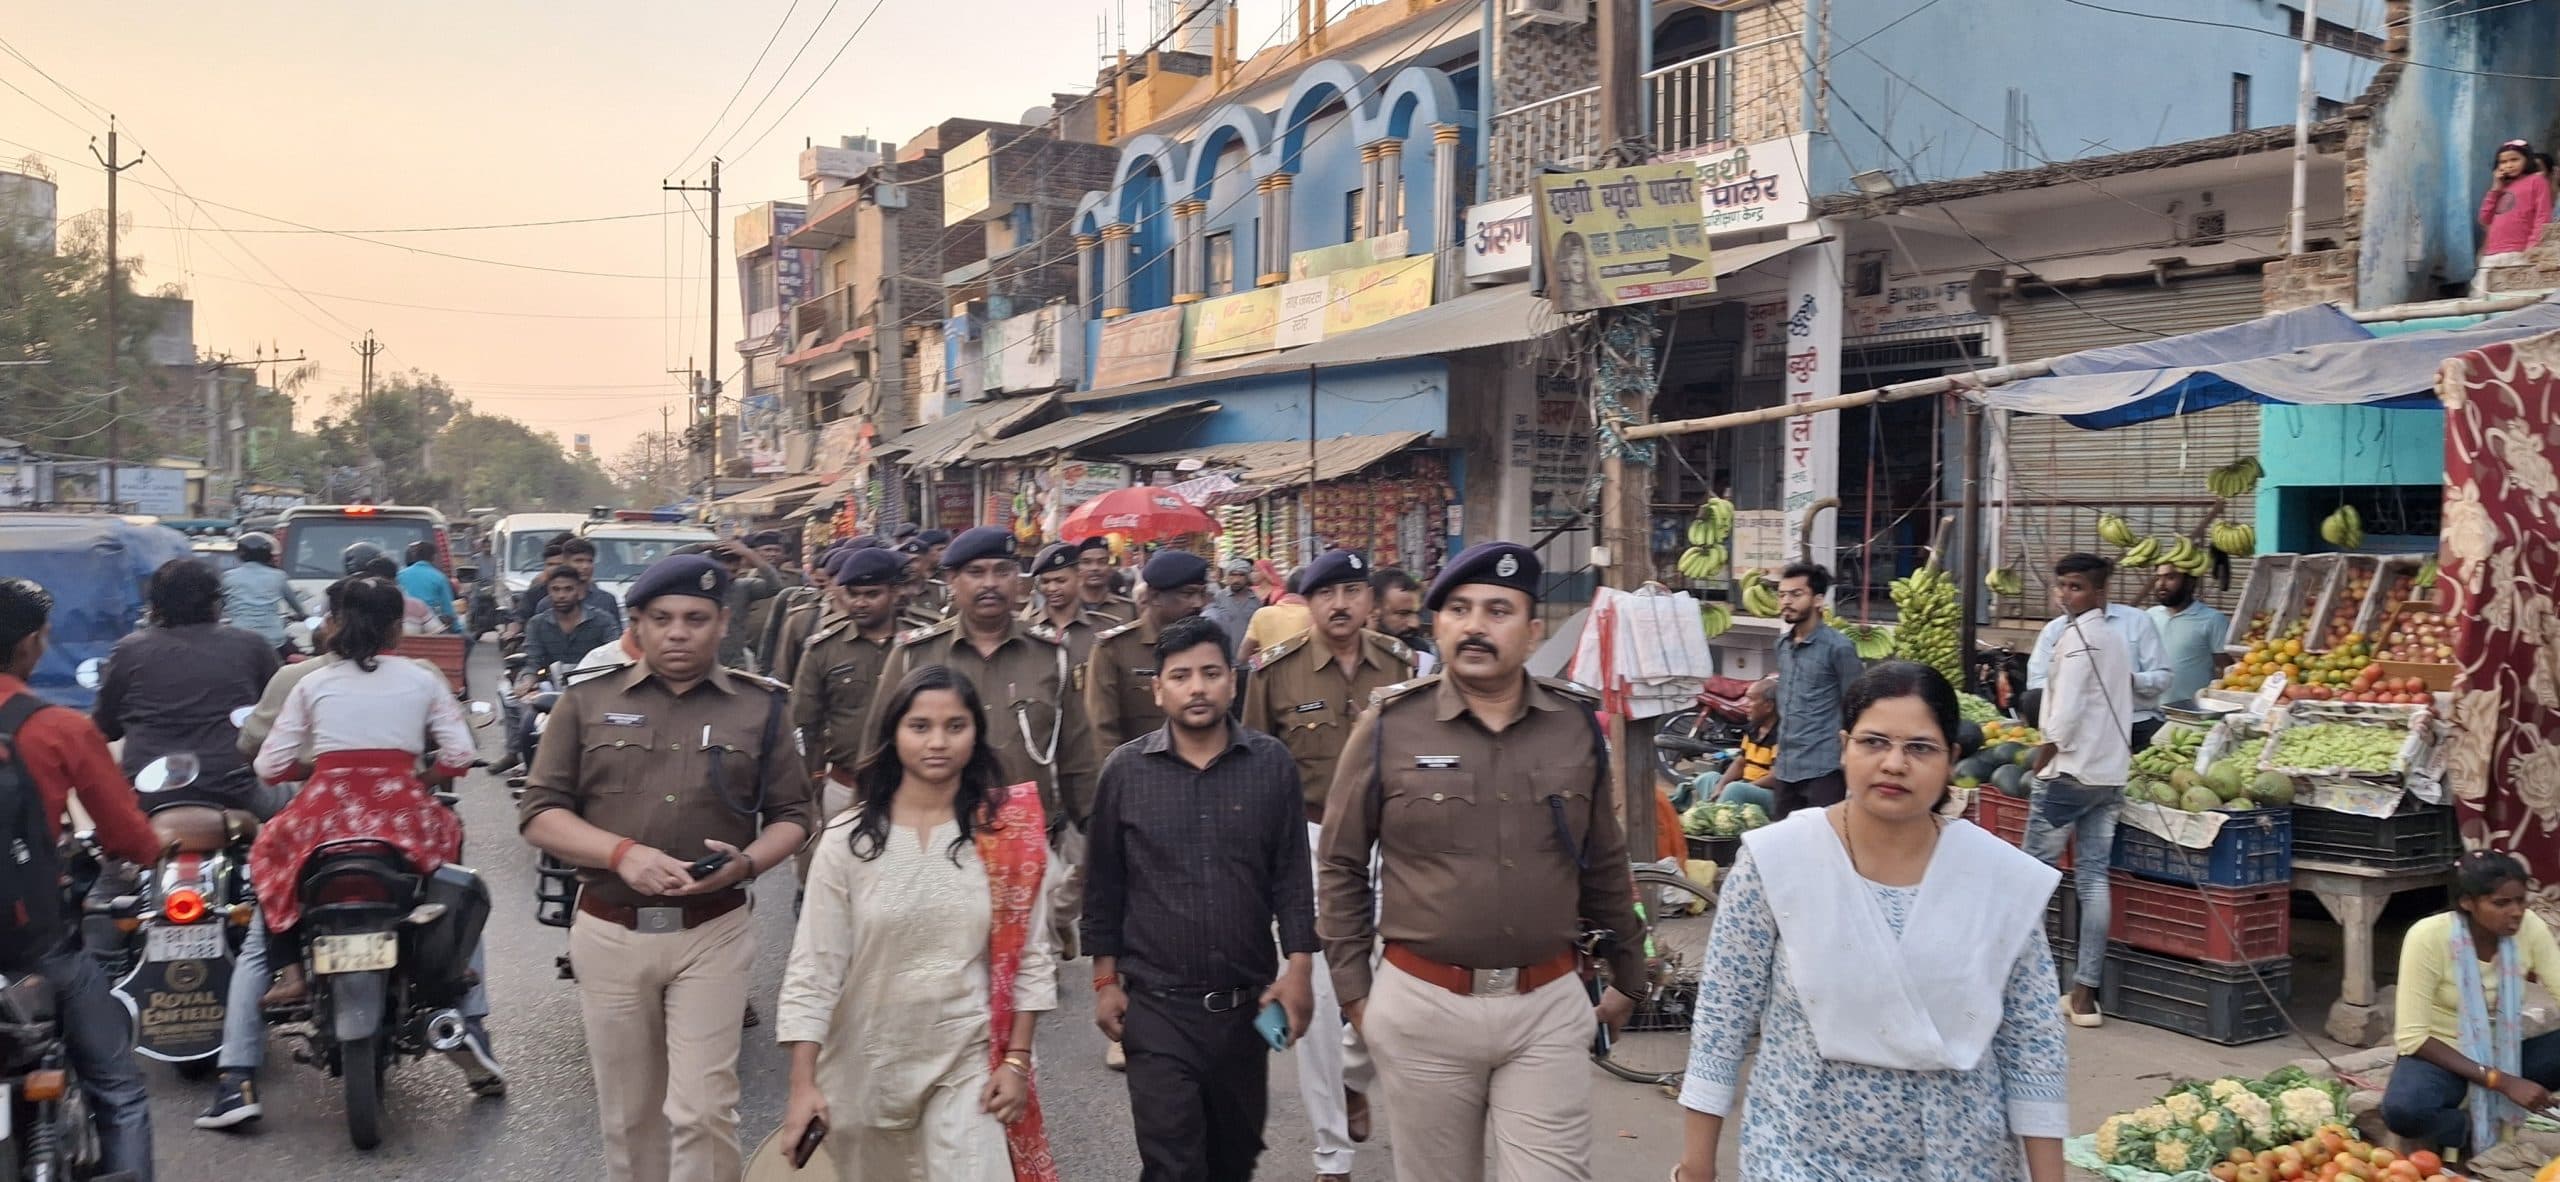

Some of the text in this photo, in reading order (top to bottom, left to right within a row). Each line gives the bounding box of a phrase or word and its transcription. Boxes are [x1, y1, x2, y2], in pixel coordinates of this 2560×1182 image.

[1546, 178, 1593, 224] खुशी
[1647, 170, 1696, 206] पार्लर
[1705, 170, 1779, 207] पार्लर
